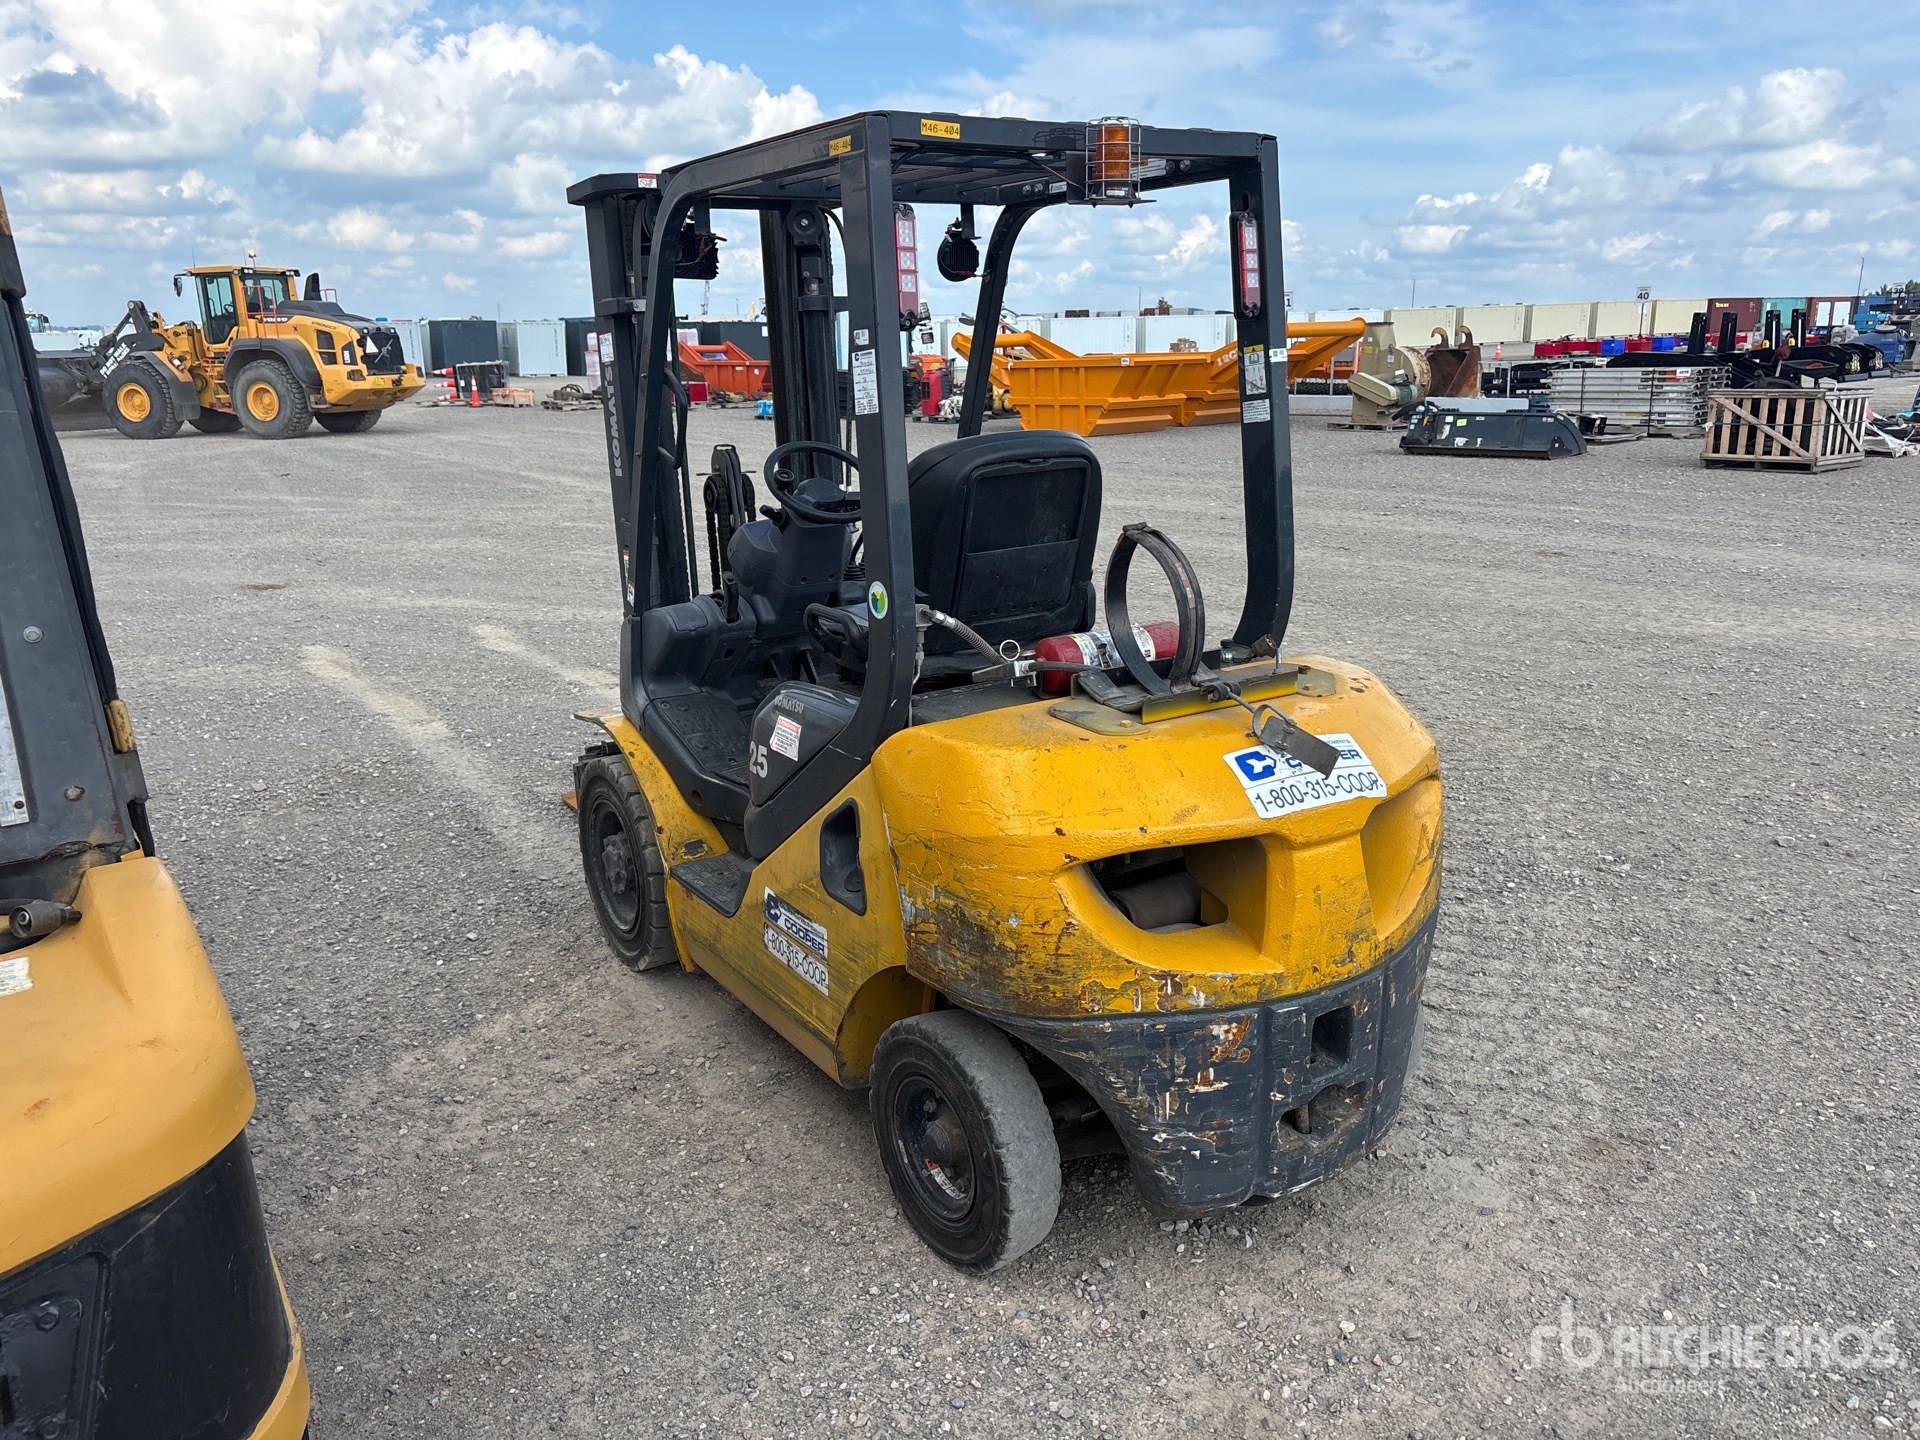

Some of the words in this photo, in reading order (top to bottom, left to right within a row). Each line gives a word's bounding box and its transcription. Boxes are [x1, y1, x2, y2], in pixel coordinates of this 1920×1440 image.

[830, 139, 851, 153] M46-404
[921, 122, 960, 136] M46-404
[1637, 292, 1650, 300] 40
[605, 362, 623, 477] KOMATS
[749, 741, 768, 778] 25
[784, 917, 825, 955] COOPER
[766, 929, 827, 987] 1-800-315-COOP
